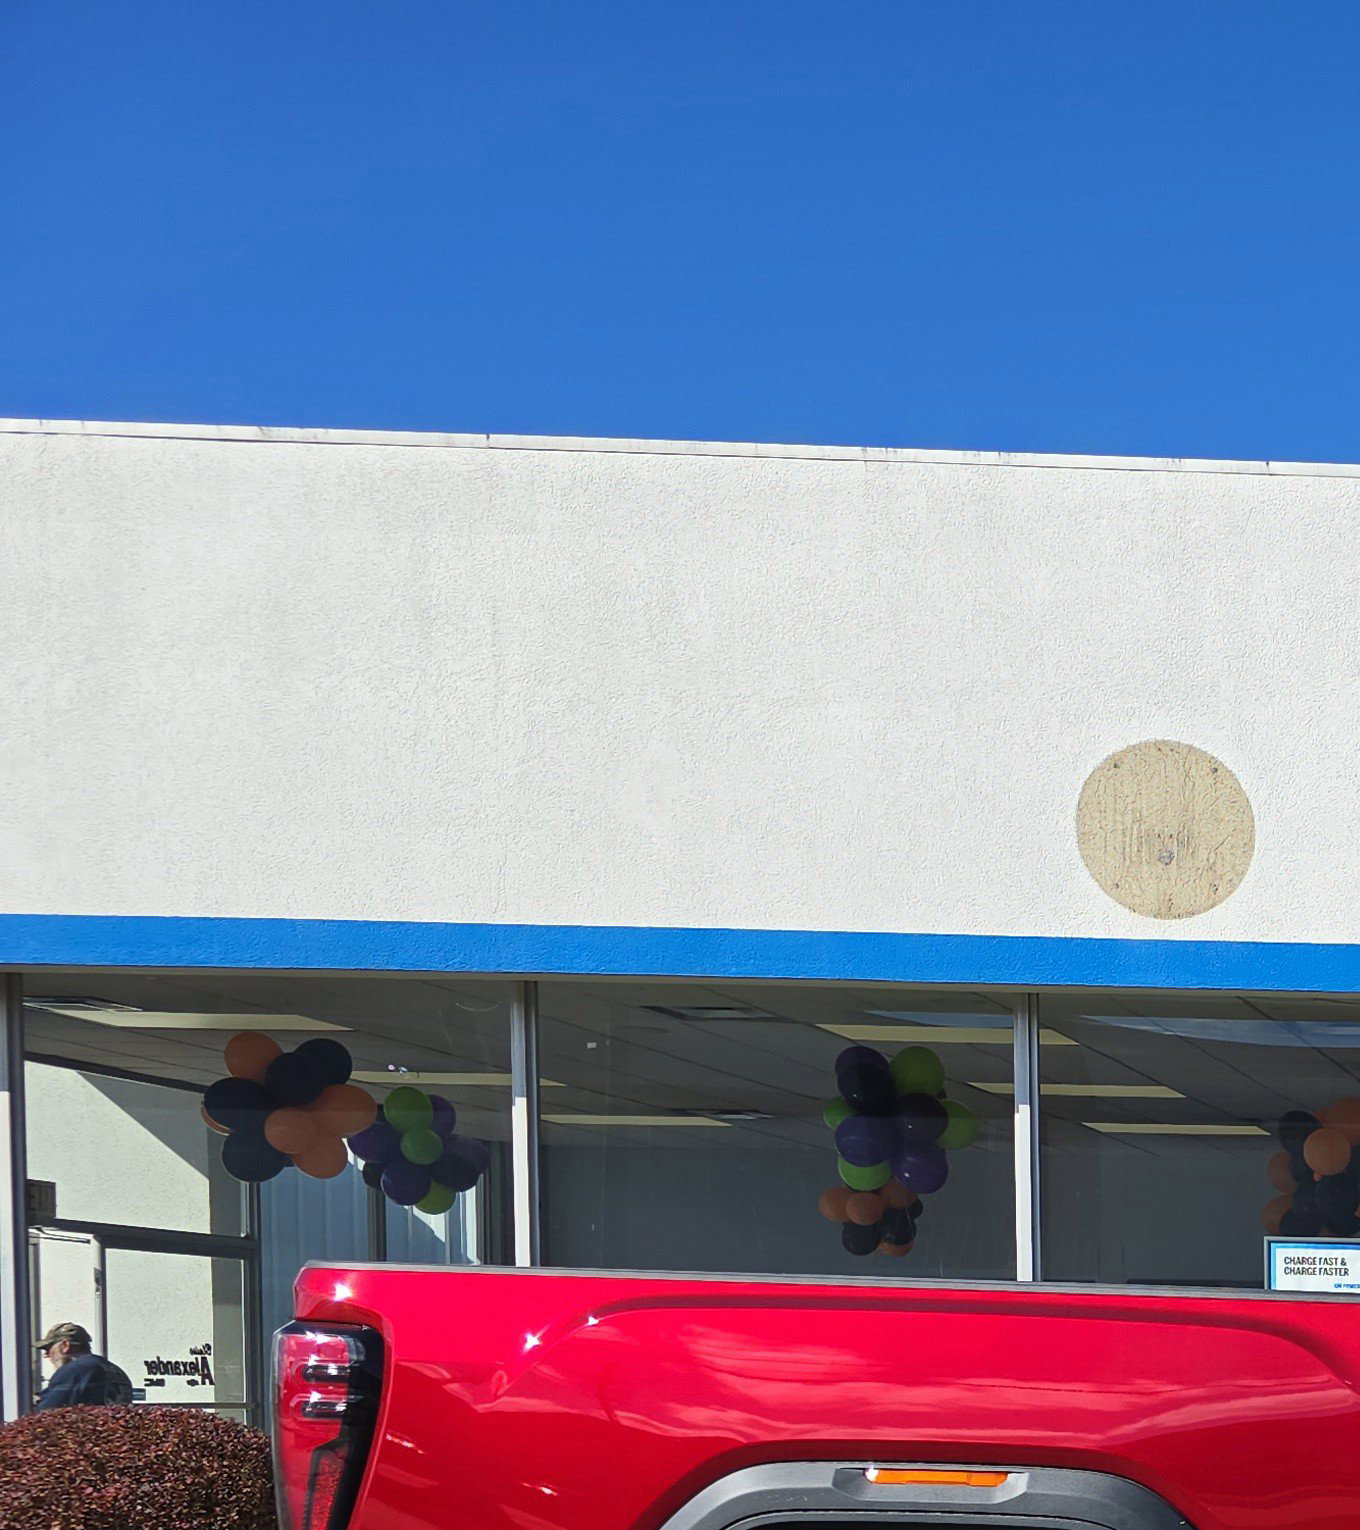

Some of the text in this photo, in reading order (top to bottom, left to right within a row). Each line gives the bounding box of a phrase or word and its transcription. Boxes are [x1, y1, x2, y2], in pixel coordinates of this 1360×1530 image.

[1283, 1256, 1347, 1267] CHARGE FAST &
[1283, 1266, 1349, 1277] CHARGE FASTER
